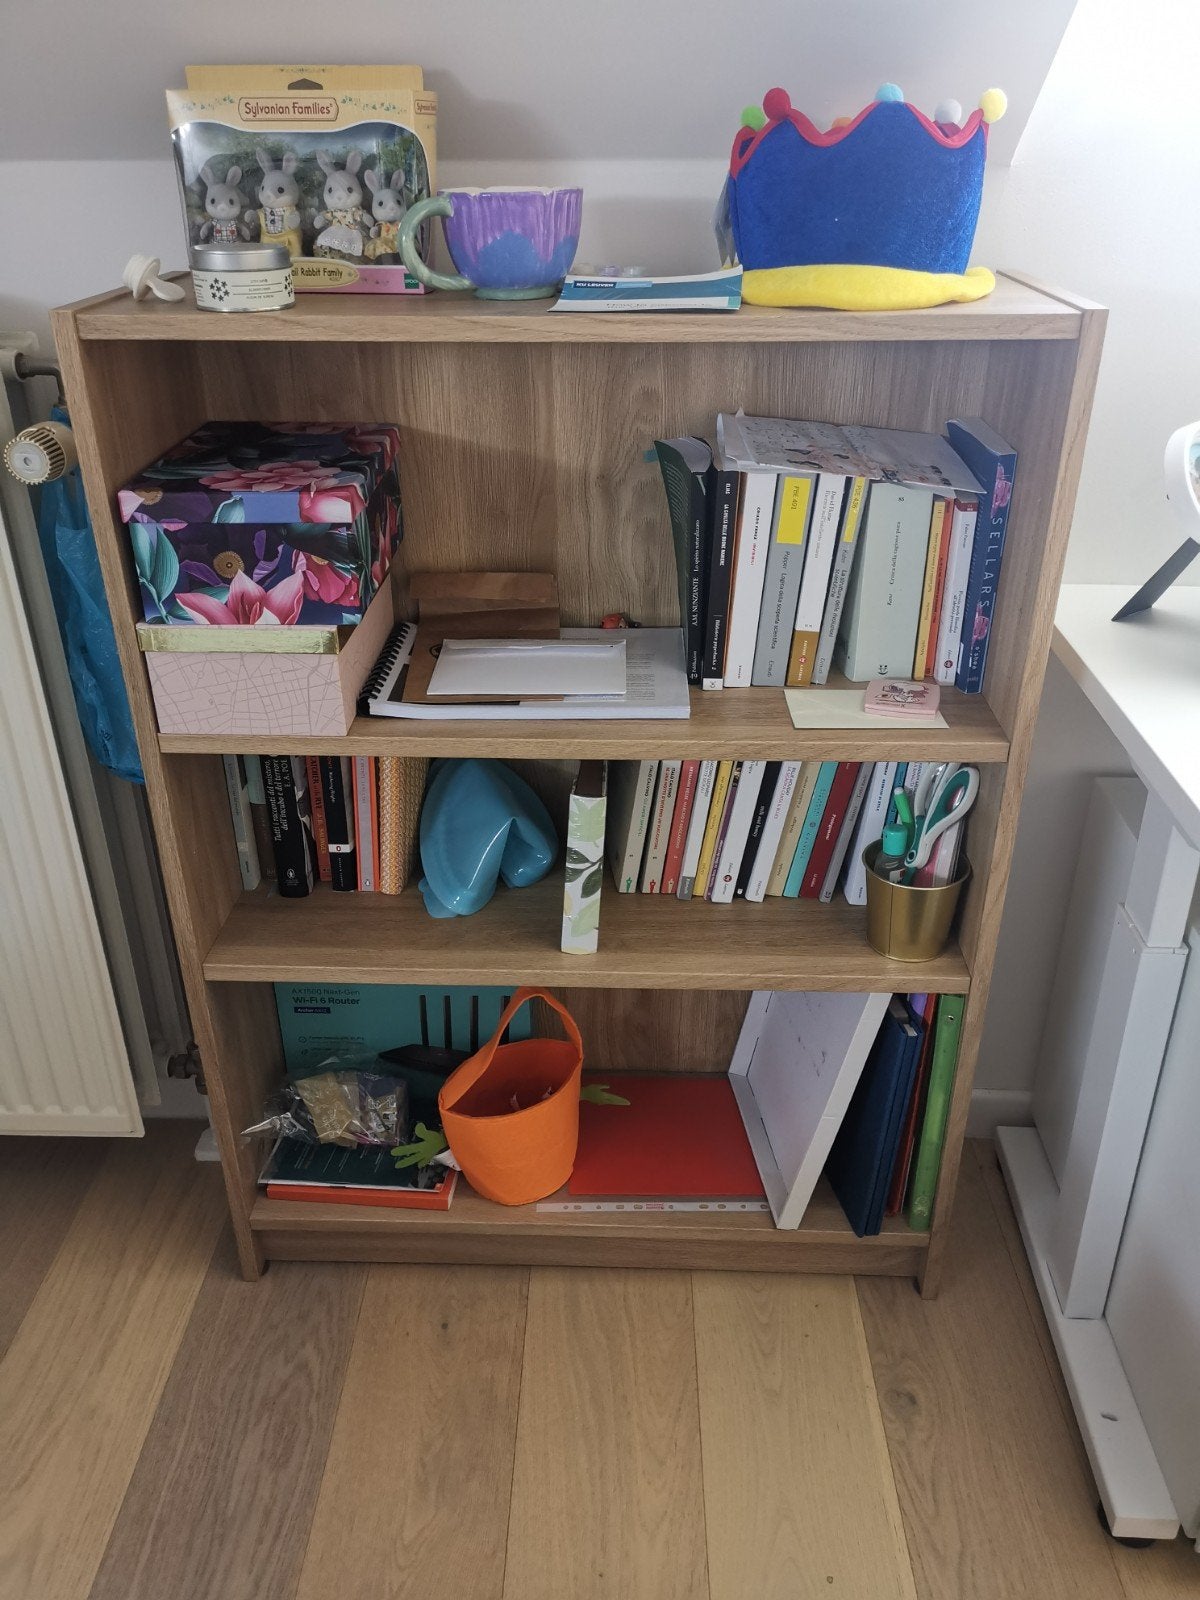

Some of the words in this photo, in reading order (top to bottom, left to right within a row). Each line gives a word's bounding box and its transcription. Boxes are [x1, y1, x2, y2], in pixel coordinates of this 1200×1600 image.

[244, 102, 290, 117] Sylvanian
[292, 102, 334, 114] Families
[300, 268, 321, 276] Rabbit
[322, 268, 343, 279] Family
[980, 517, 1003, 607] SELLARS
[691, 576, 699, 611] NUNZIANTE
[310, 756, 320, 784] ATCHER
[279, 796, 288, 830] dell'incubo
[752, 825, 760, 838] honey
[292, 996, 318, 1004] Wi-Fi
